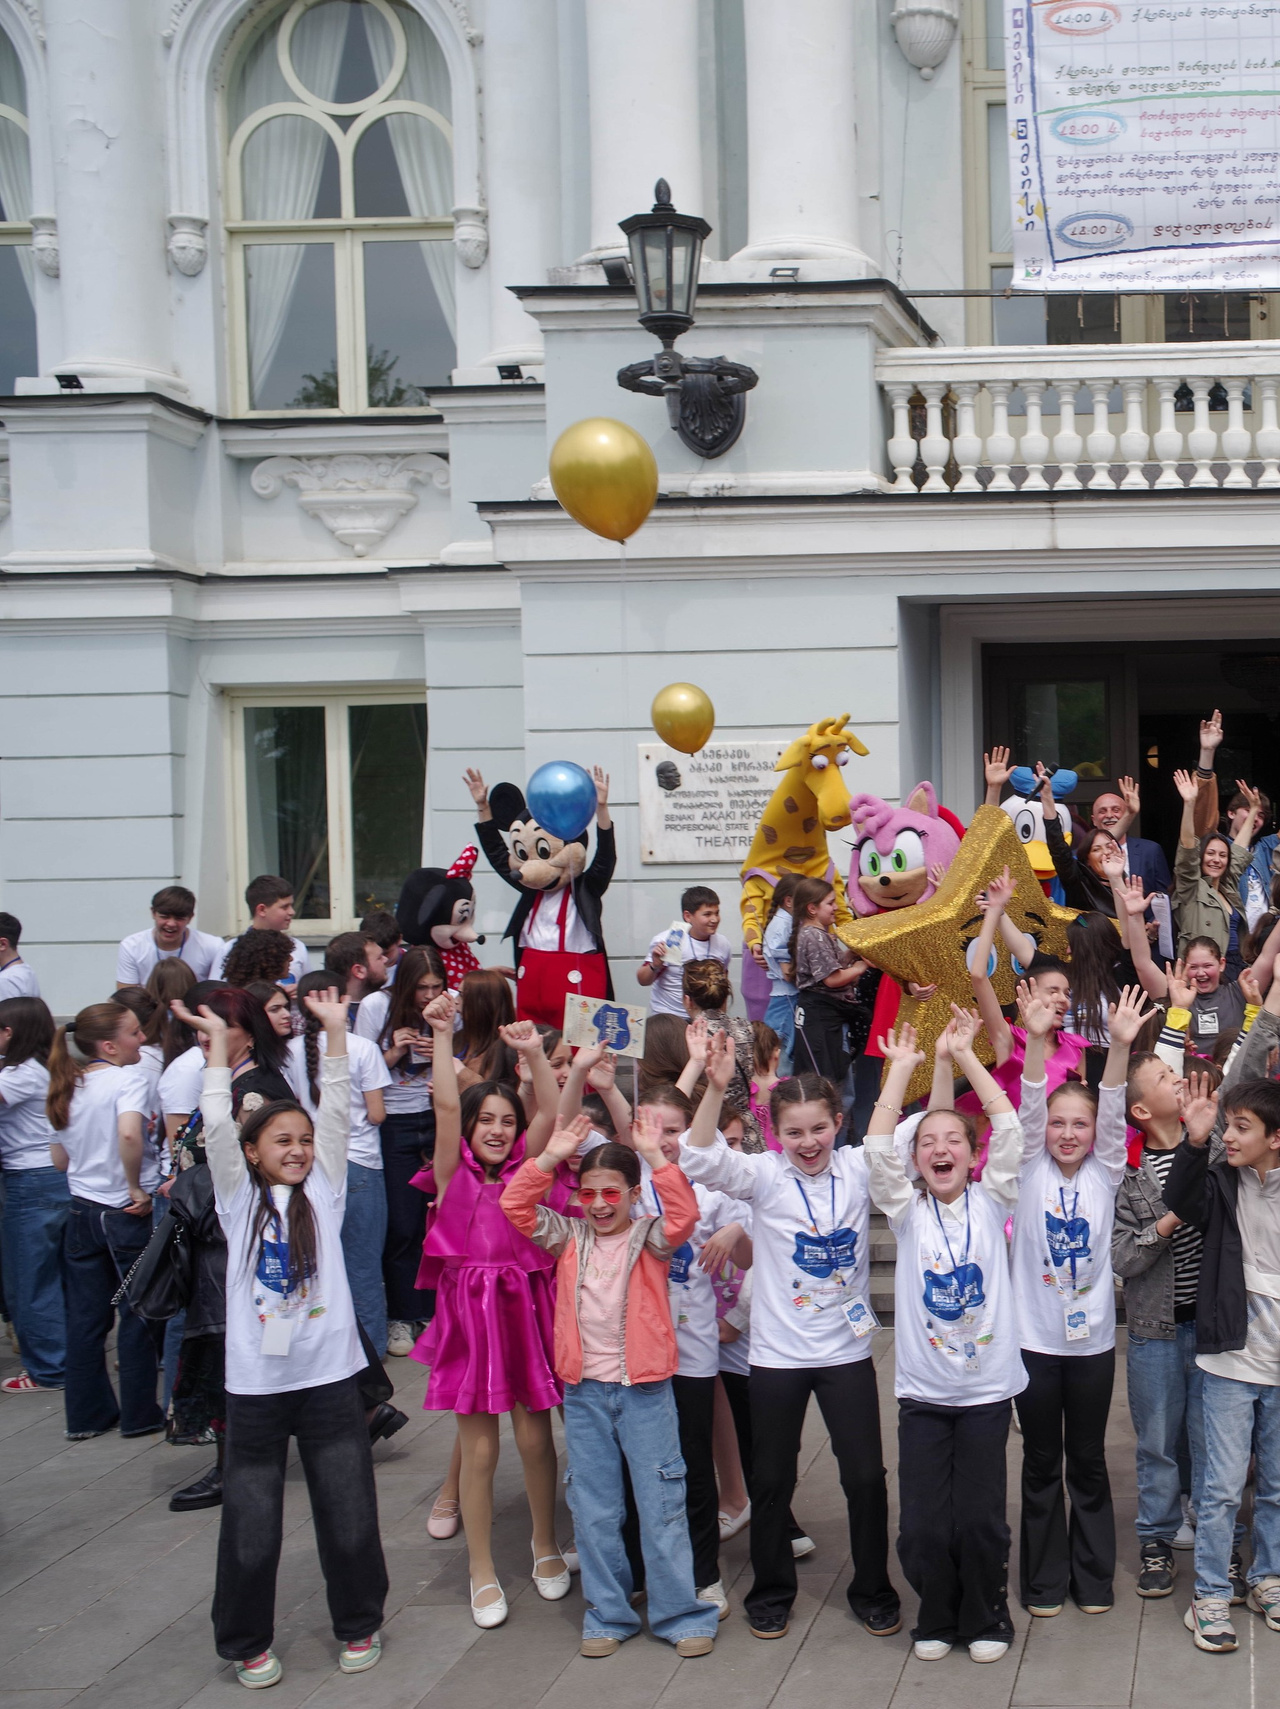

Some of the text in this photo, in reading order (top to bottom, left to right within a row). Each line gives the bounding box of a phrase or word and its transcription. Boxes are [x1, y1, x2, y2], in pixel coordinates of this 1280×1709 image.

[1054, 14, 1092, 25] 14:00
[1059, 123, 1100, 137] 12:00
[1069, 224, 1108, 237] 18:00
[702, 749, 751, 760] სენაკის
[689, 761, 722, 774] აკაკი
[664, 813, 695, 822] SENAKI
[701, 811, 736, 821] AKAKI
[725, 823, 750, 831] STATE
